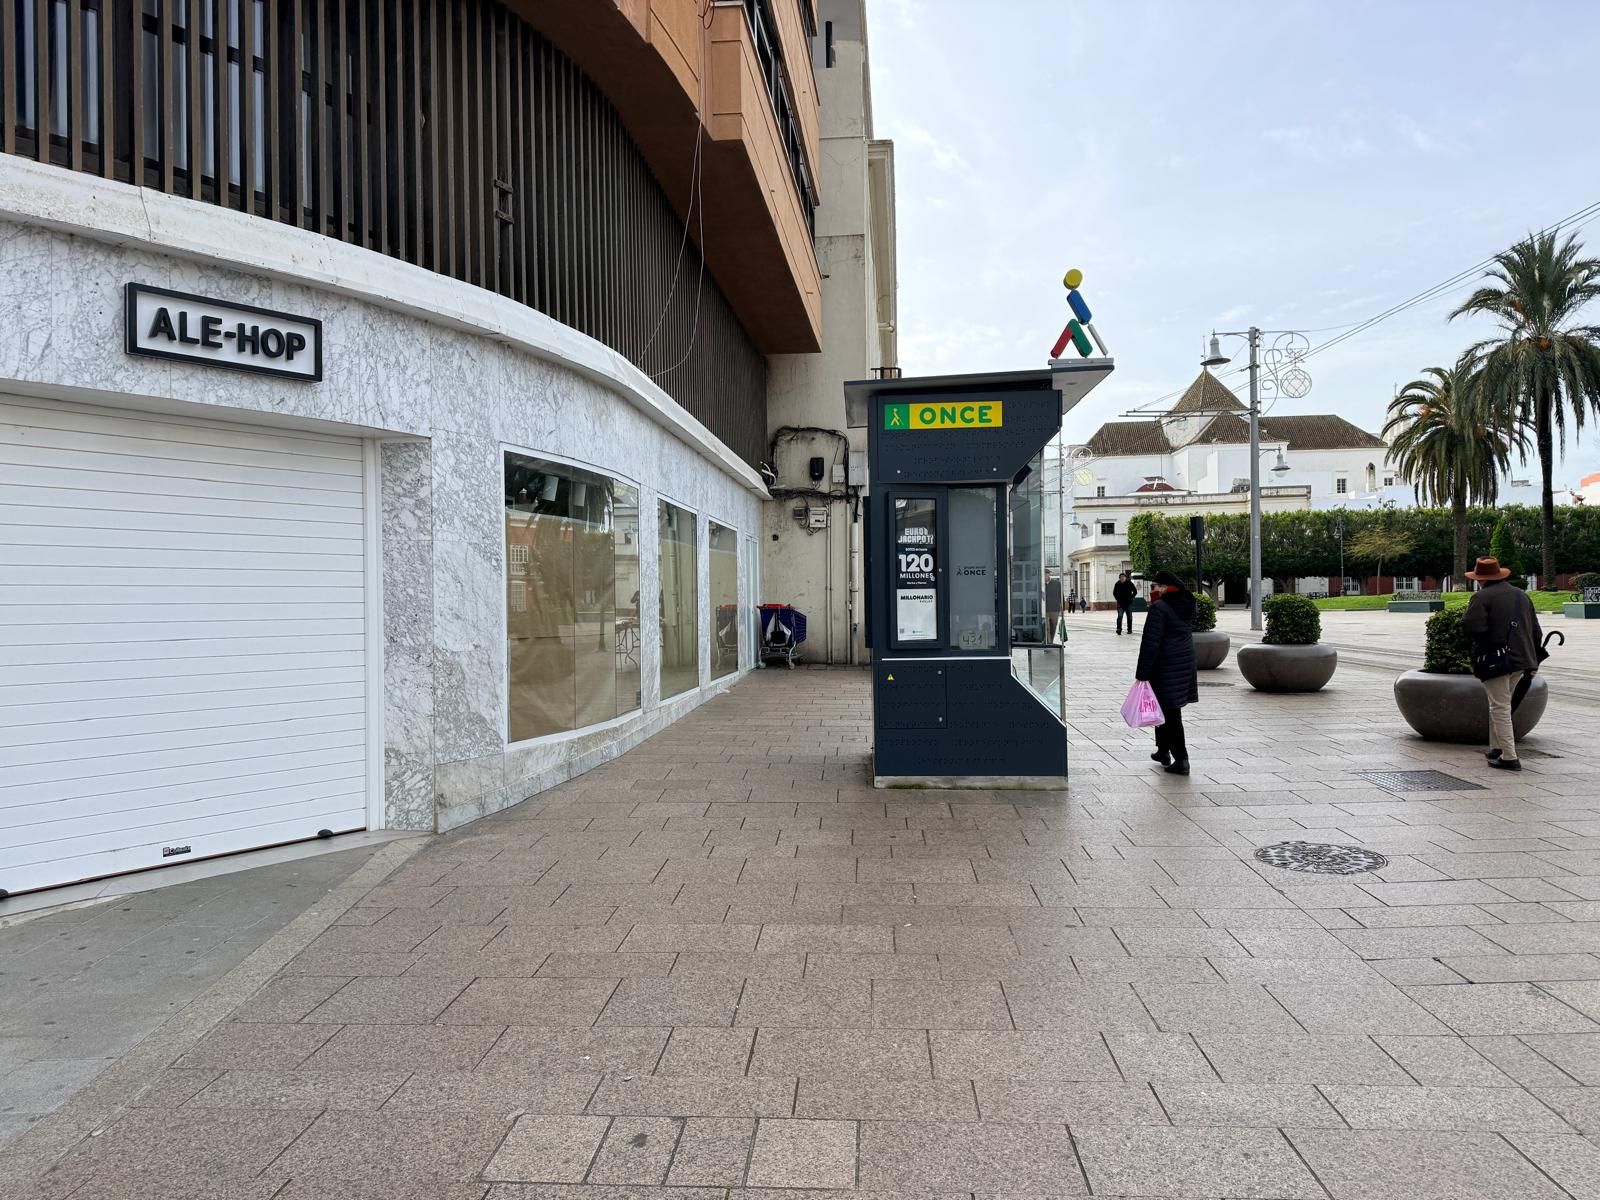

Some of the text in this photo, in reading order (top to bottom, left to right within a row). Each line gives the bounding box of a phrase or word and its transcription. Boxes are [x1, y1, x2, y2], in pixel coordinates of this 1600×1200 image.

[149, 307, 306, 361] ALE-HOP
[919, 405, 993, 425] ONCE
[898, 553, 934, 572] 120
